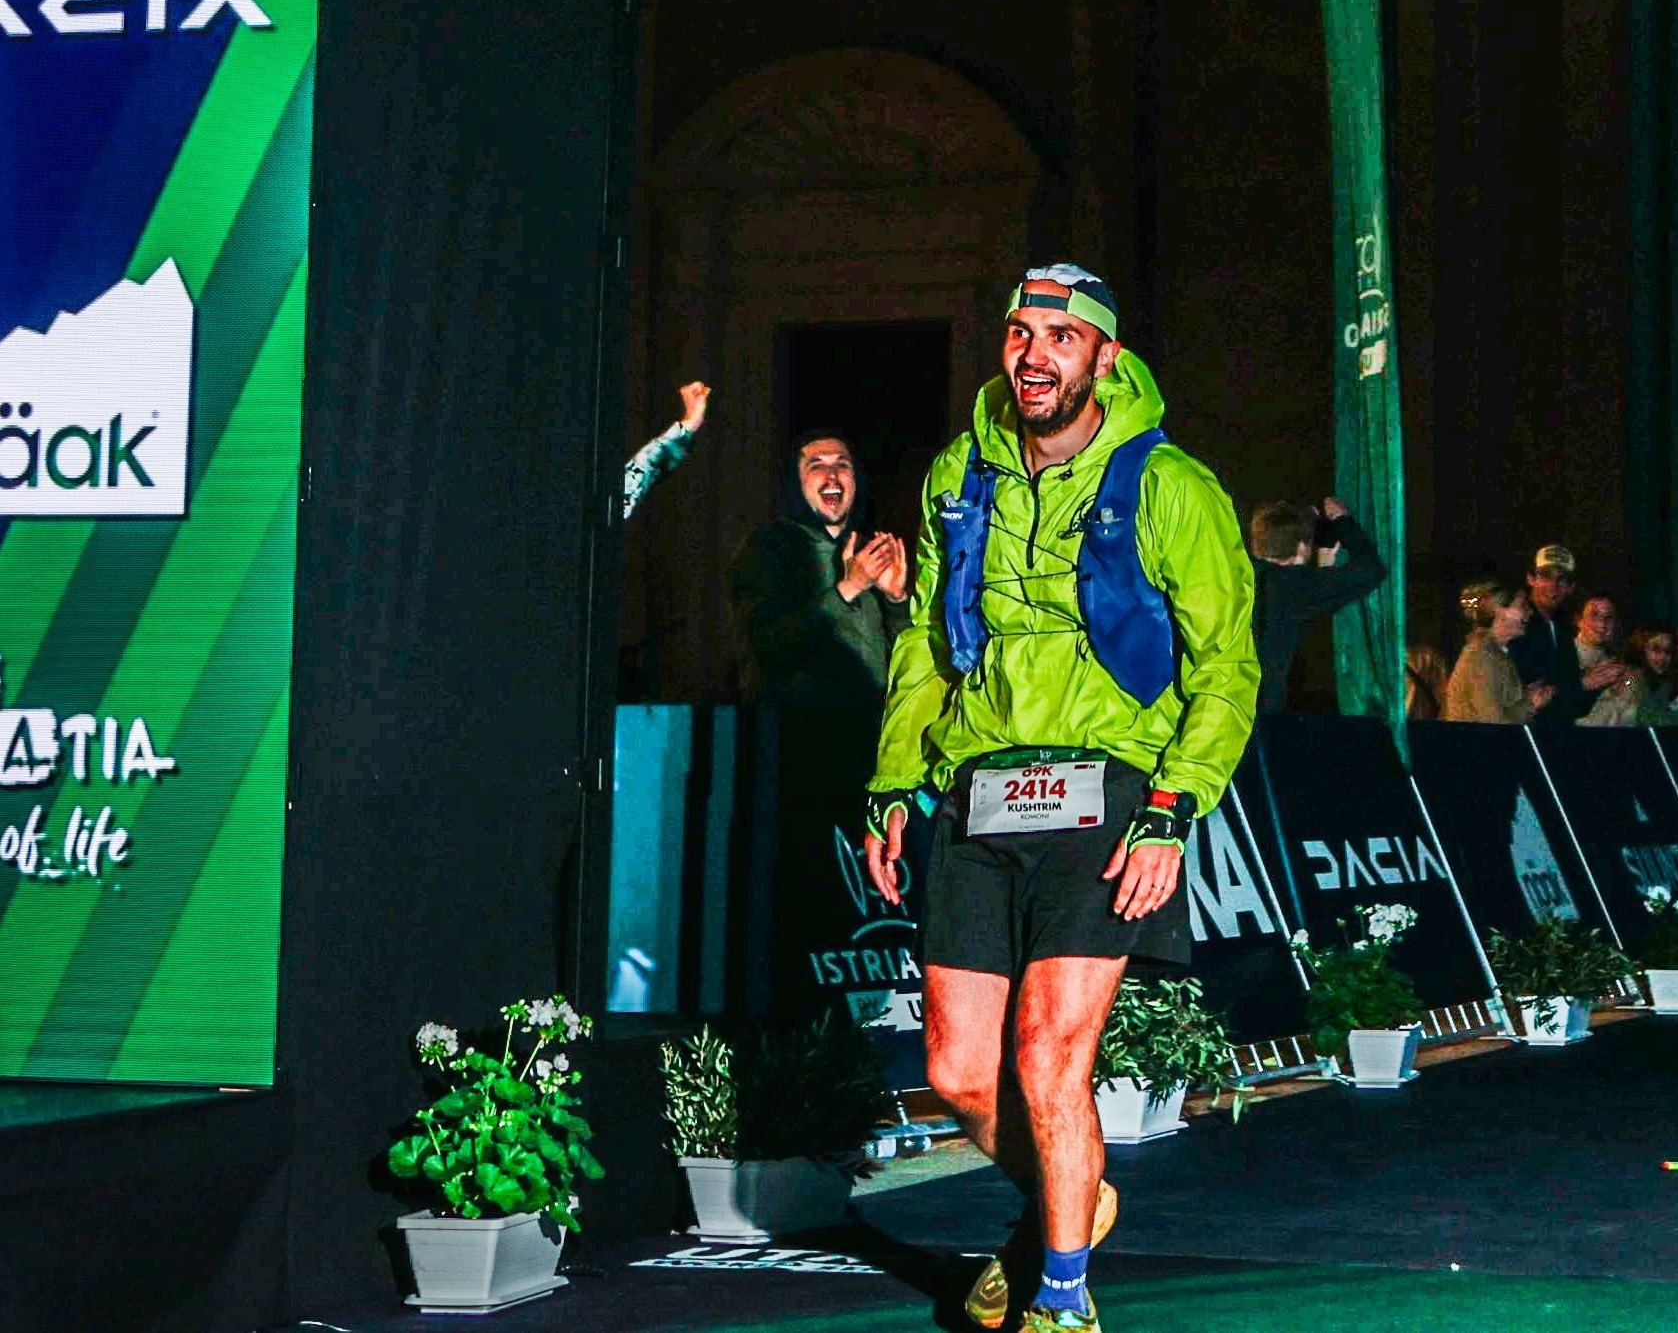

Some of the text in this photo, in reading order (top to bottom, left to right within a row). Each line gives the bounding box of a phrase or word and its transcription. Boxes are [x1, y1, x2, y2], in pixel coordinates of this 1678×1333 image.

[1003, 778, 1067, 802] 2414
[1007, 802, 1062, 813] KUSHTRIM
[0, 805, 129, 877] of life
[1302, 835, 1448, 890] DACIA
[810, 948, 922, 985] ISTRIA
